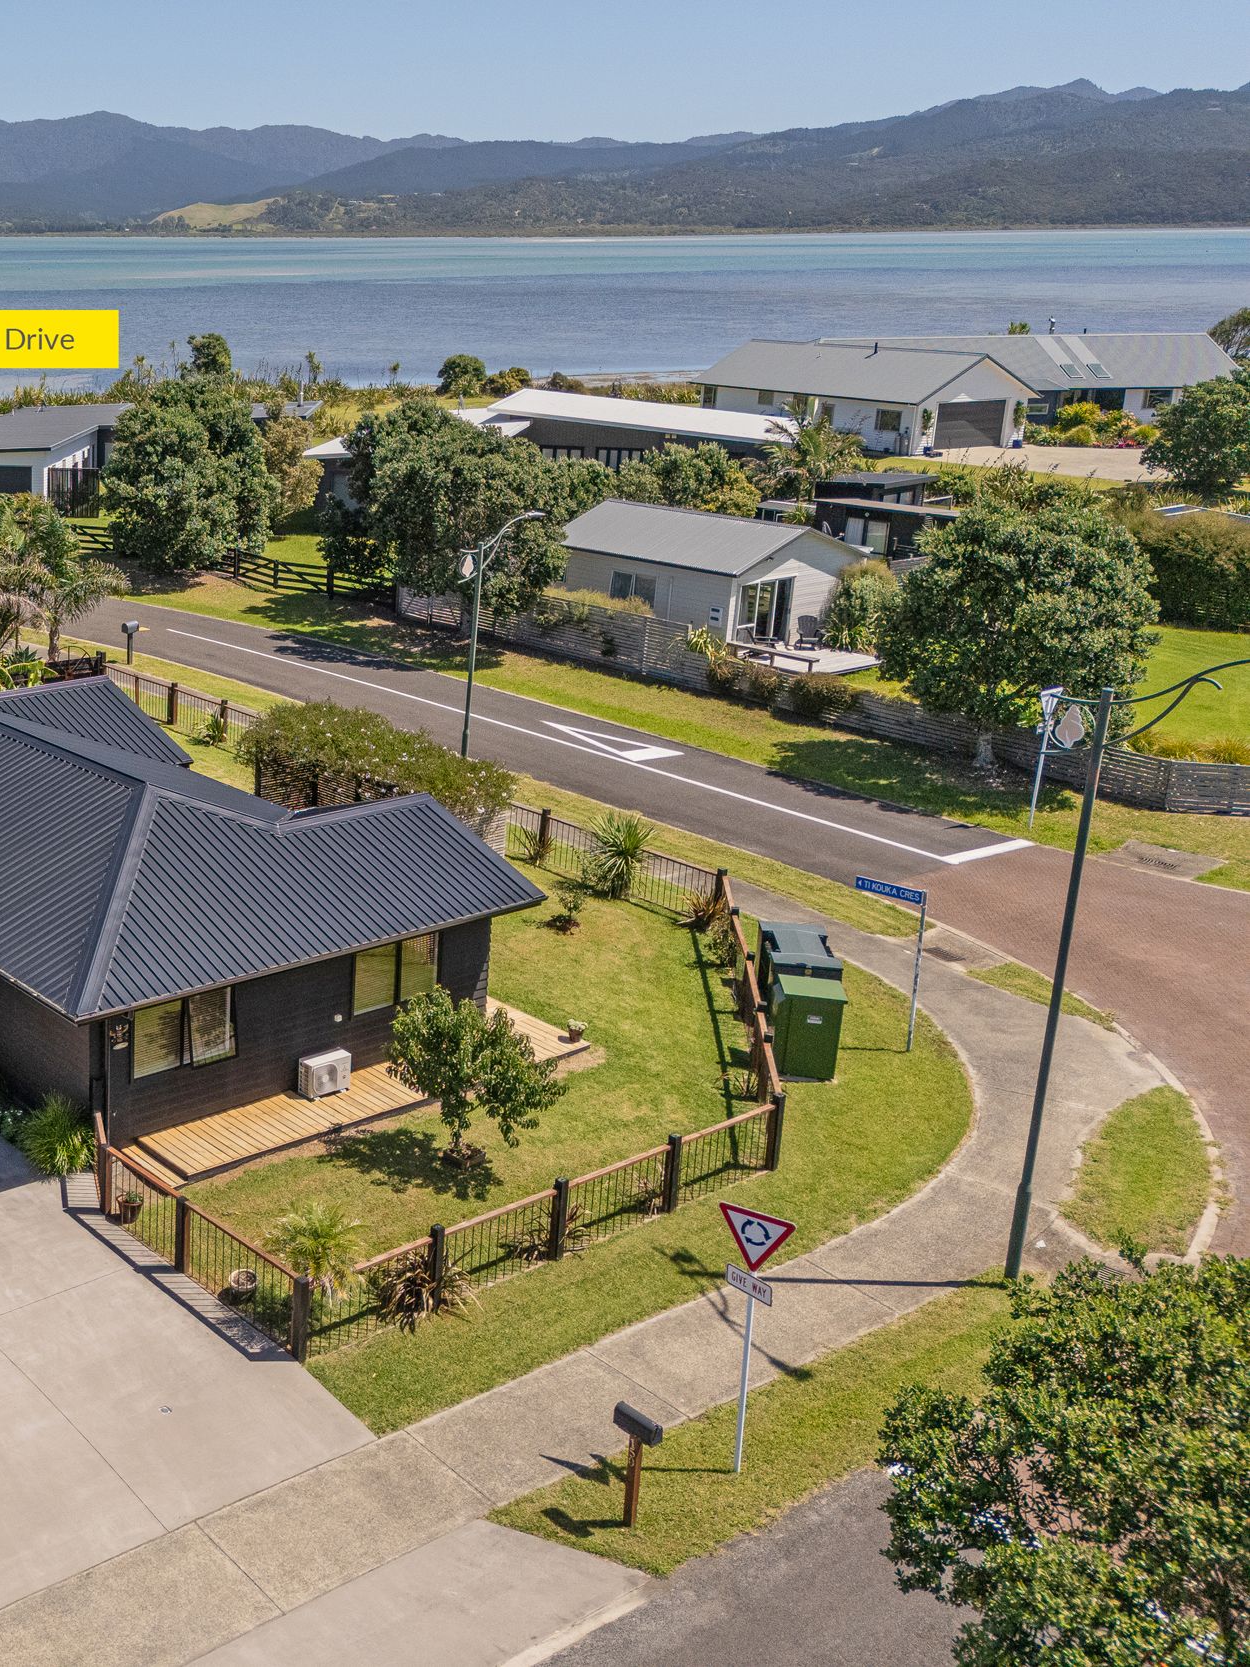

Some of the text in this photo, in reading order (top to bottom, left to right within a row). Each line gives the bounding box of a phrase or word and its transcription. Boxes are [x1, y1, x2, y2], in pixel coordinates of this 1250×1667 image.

[863, 880, 920, 902] TI KOUKA CRES
[731, 1271, 767, 1298] GIVE WAY
